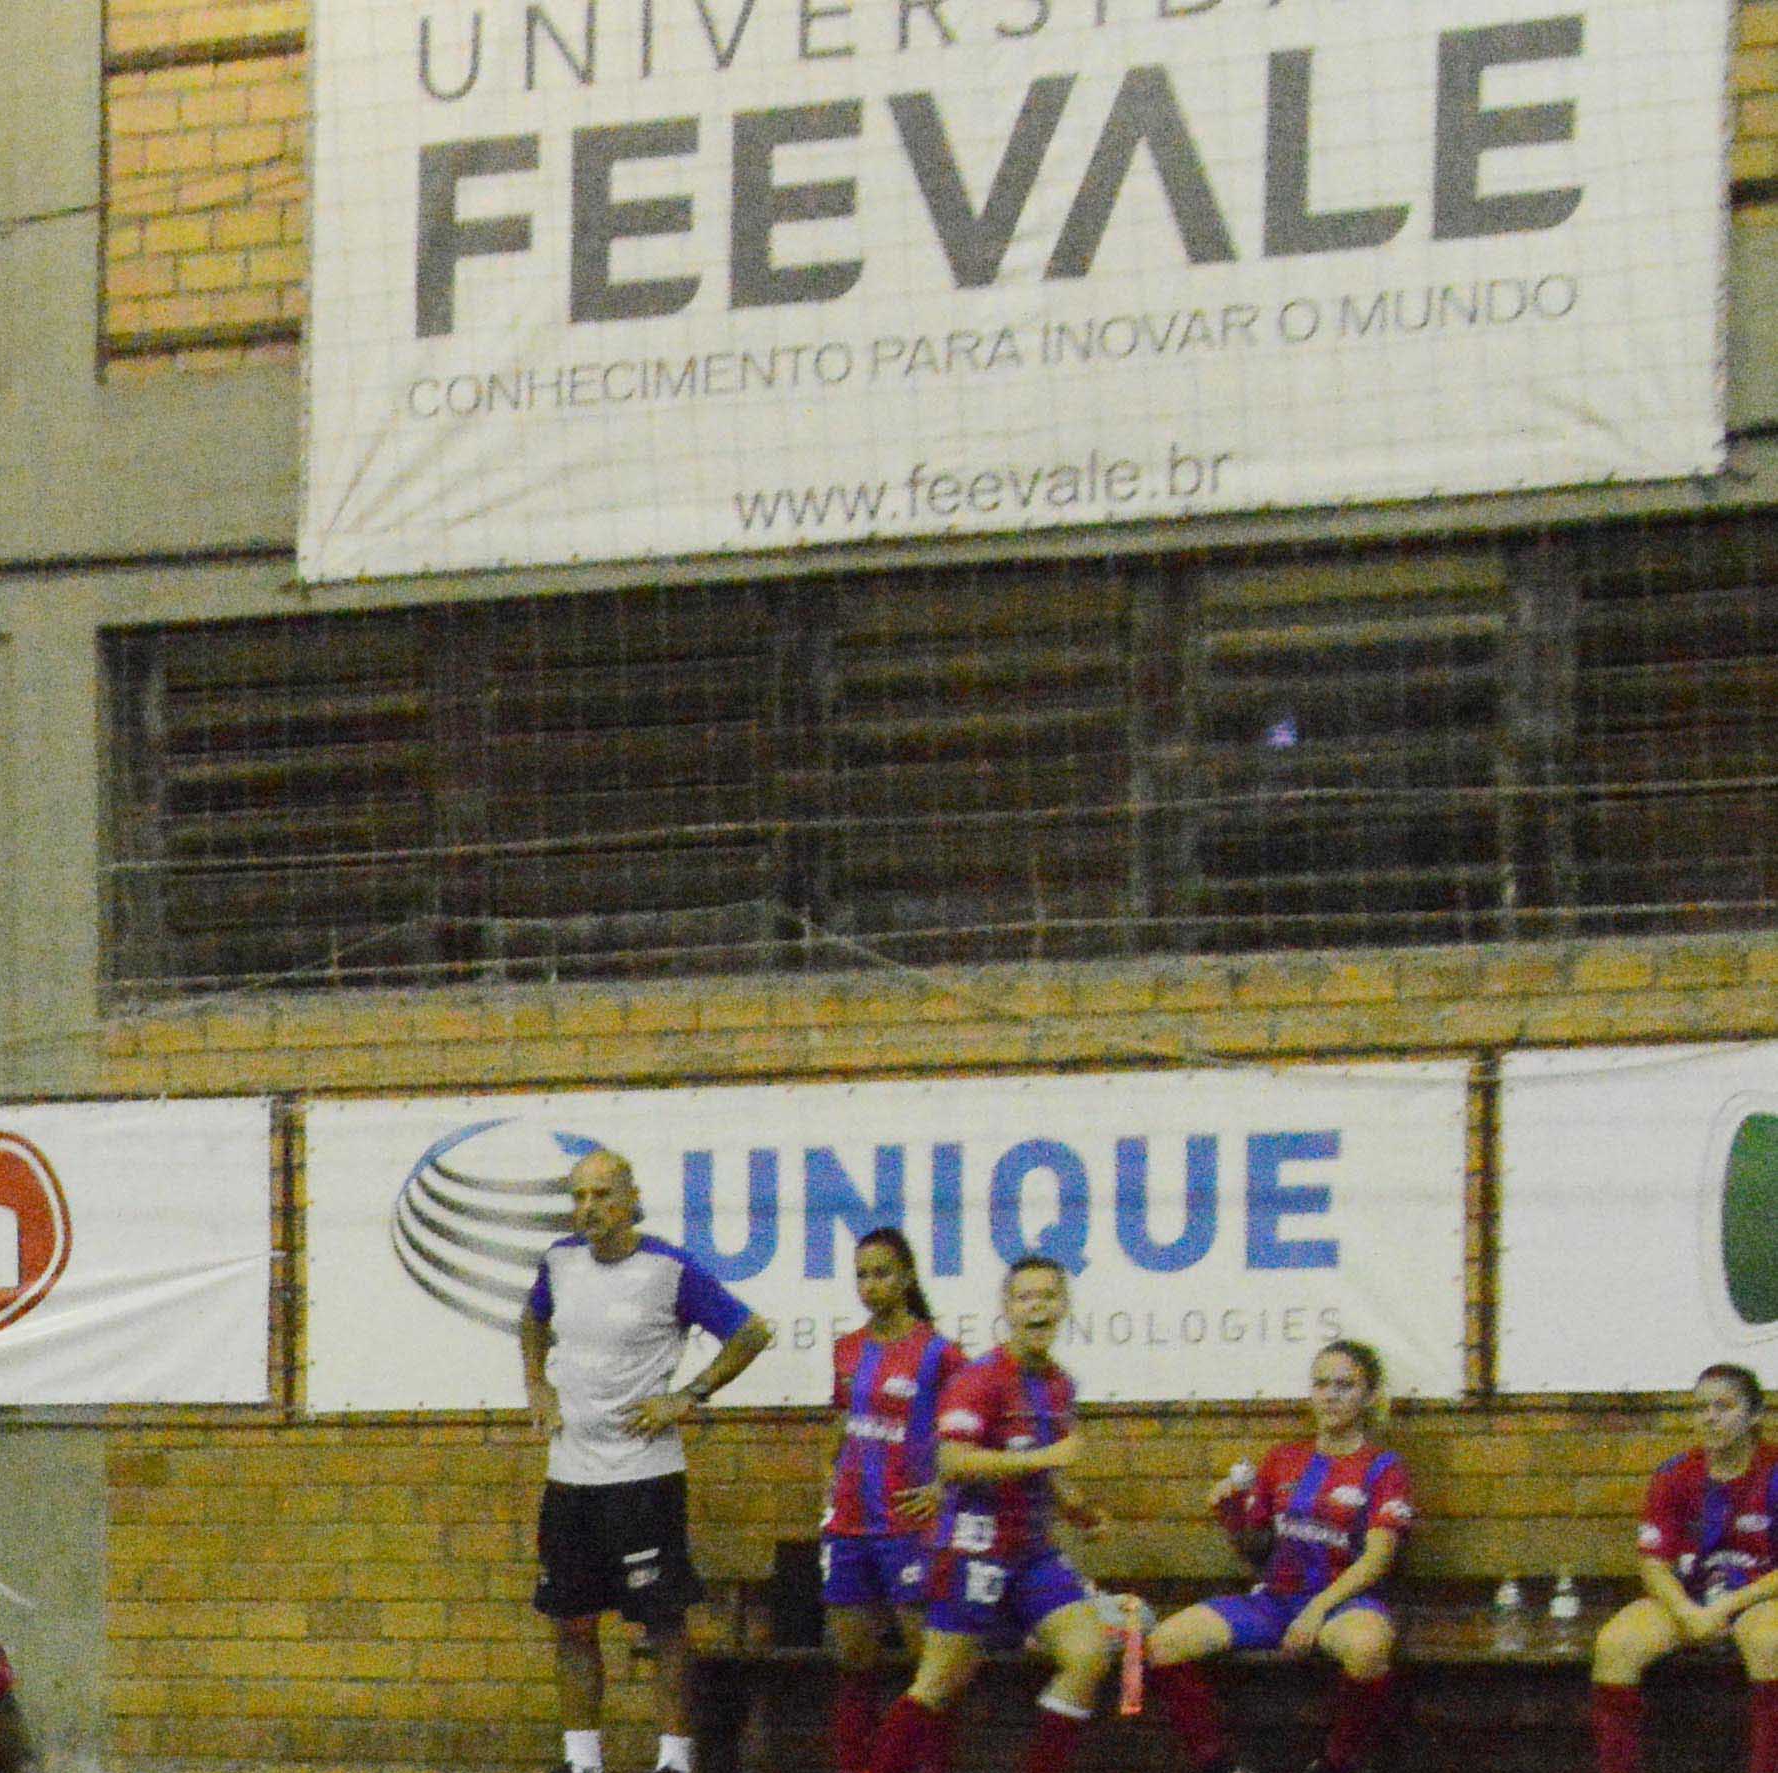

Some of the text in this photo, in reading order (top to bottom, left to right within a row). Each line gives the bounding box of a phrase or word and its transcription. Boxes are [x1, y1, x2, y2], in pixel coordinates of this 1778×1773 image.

[415, 15, 1585, 338] FEEVALE
[407, 273, 1580, 420] CONHECIMENTO PARA INOVAR O MUNDO
[733, 441, 1234, 529] www.feevale.br
[683, 1130, 1342, 1281] UNIQUE
